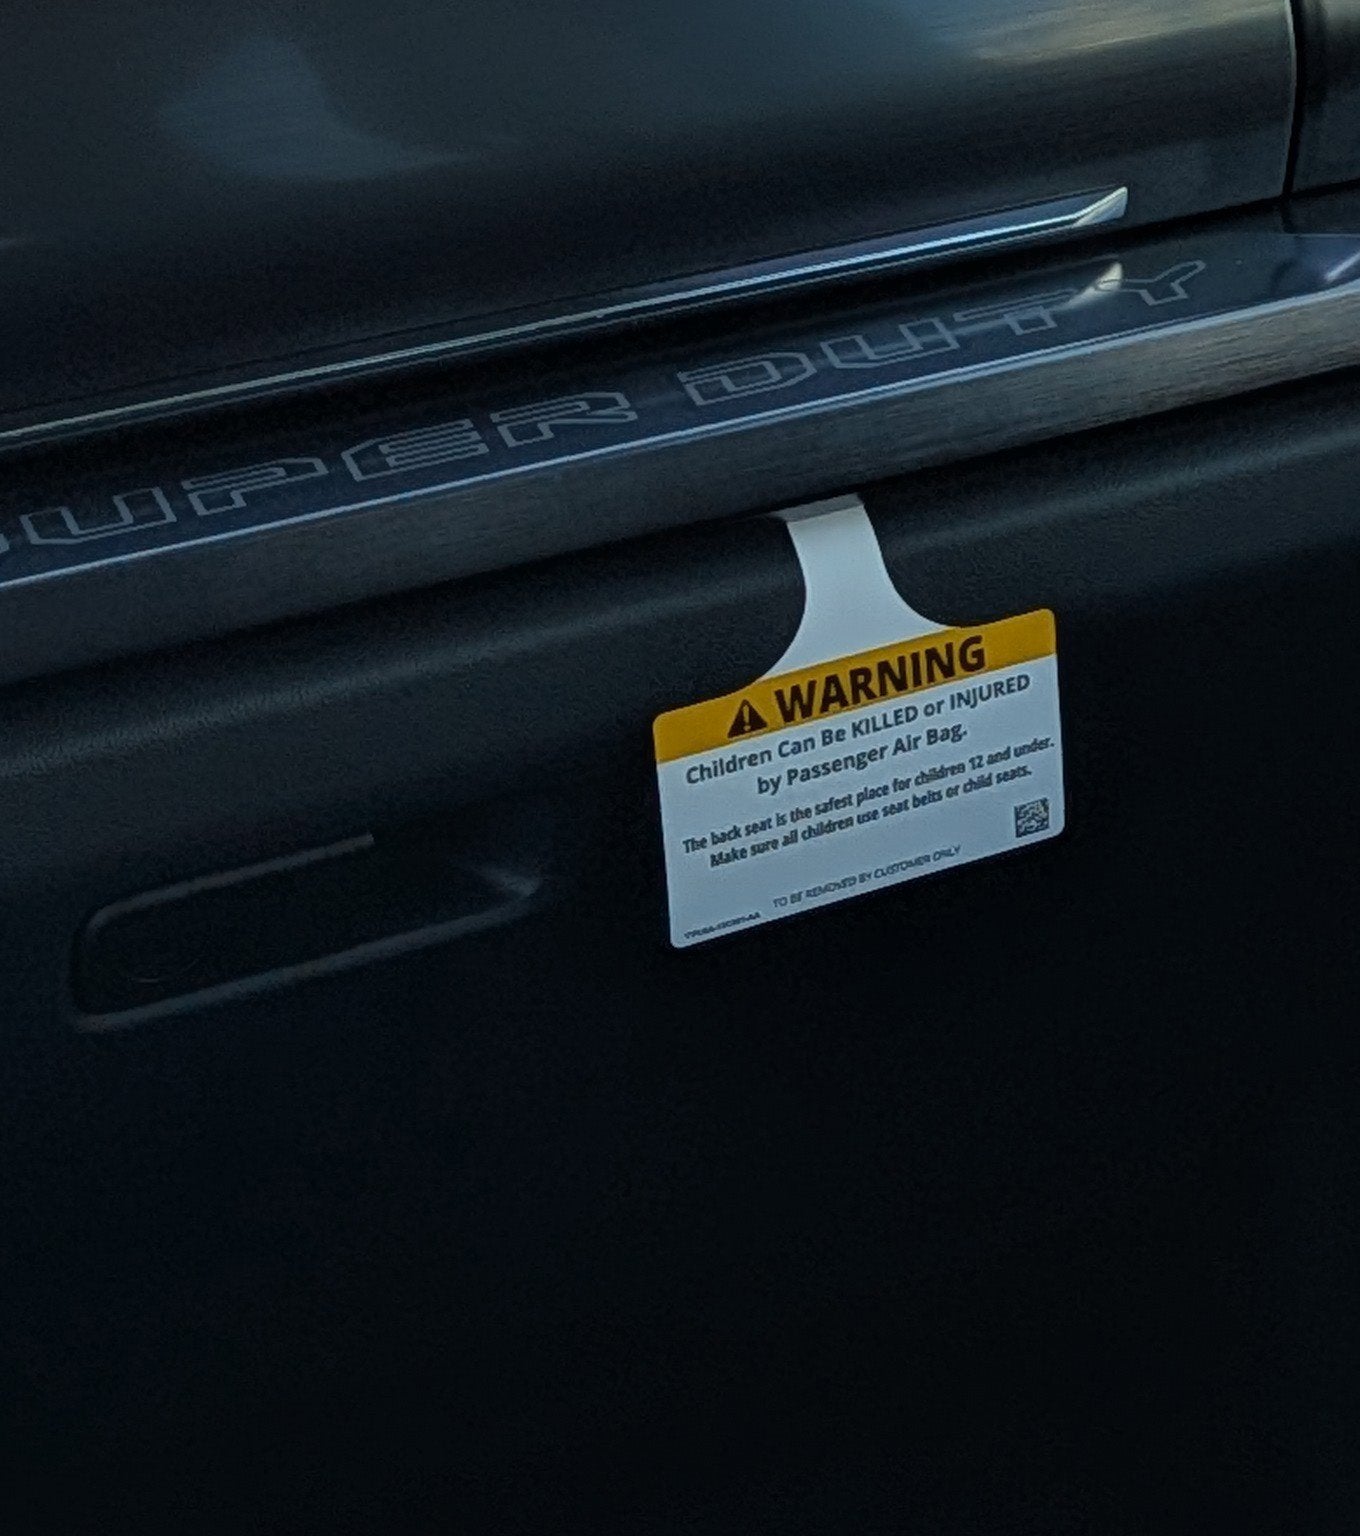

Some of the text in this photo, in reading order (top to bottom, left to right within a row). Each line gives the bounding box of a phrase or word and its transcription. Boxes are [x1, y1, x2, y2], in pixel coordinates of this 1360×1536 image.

[0, 260, 1207, 554] UPER DUTY
[686, 673, 1031, 785] Children Can Be KILLED or INJURED
[774, 635, 986, 724] WARNING
[682, 736, 1055, 854] The back seat is the safest place for children 12 and under.
[757, 722, 968, 797] by Passenger Air Bag.
[709, 763, 1032, 868] Make sure all children use seat belts or child seats.
[772, 895, 788, 908] TO
[805, 875, 857, 899] REMOVED
[873, 854, 931, 879] CUSTOMER
